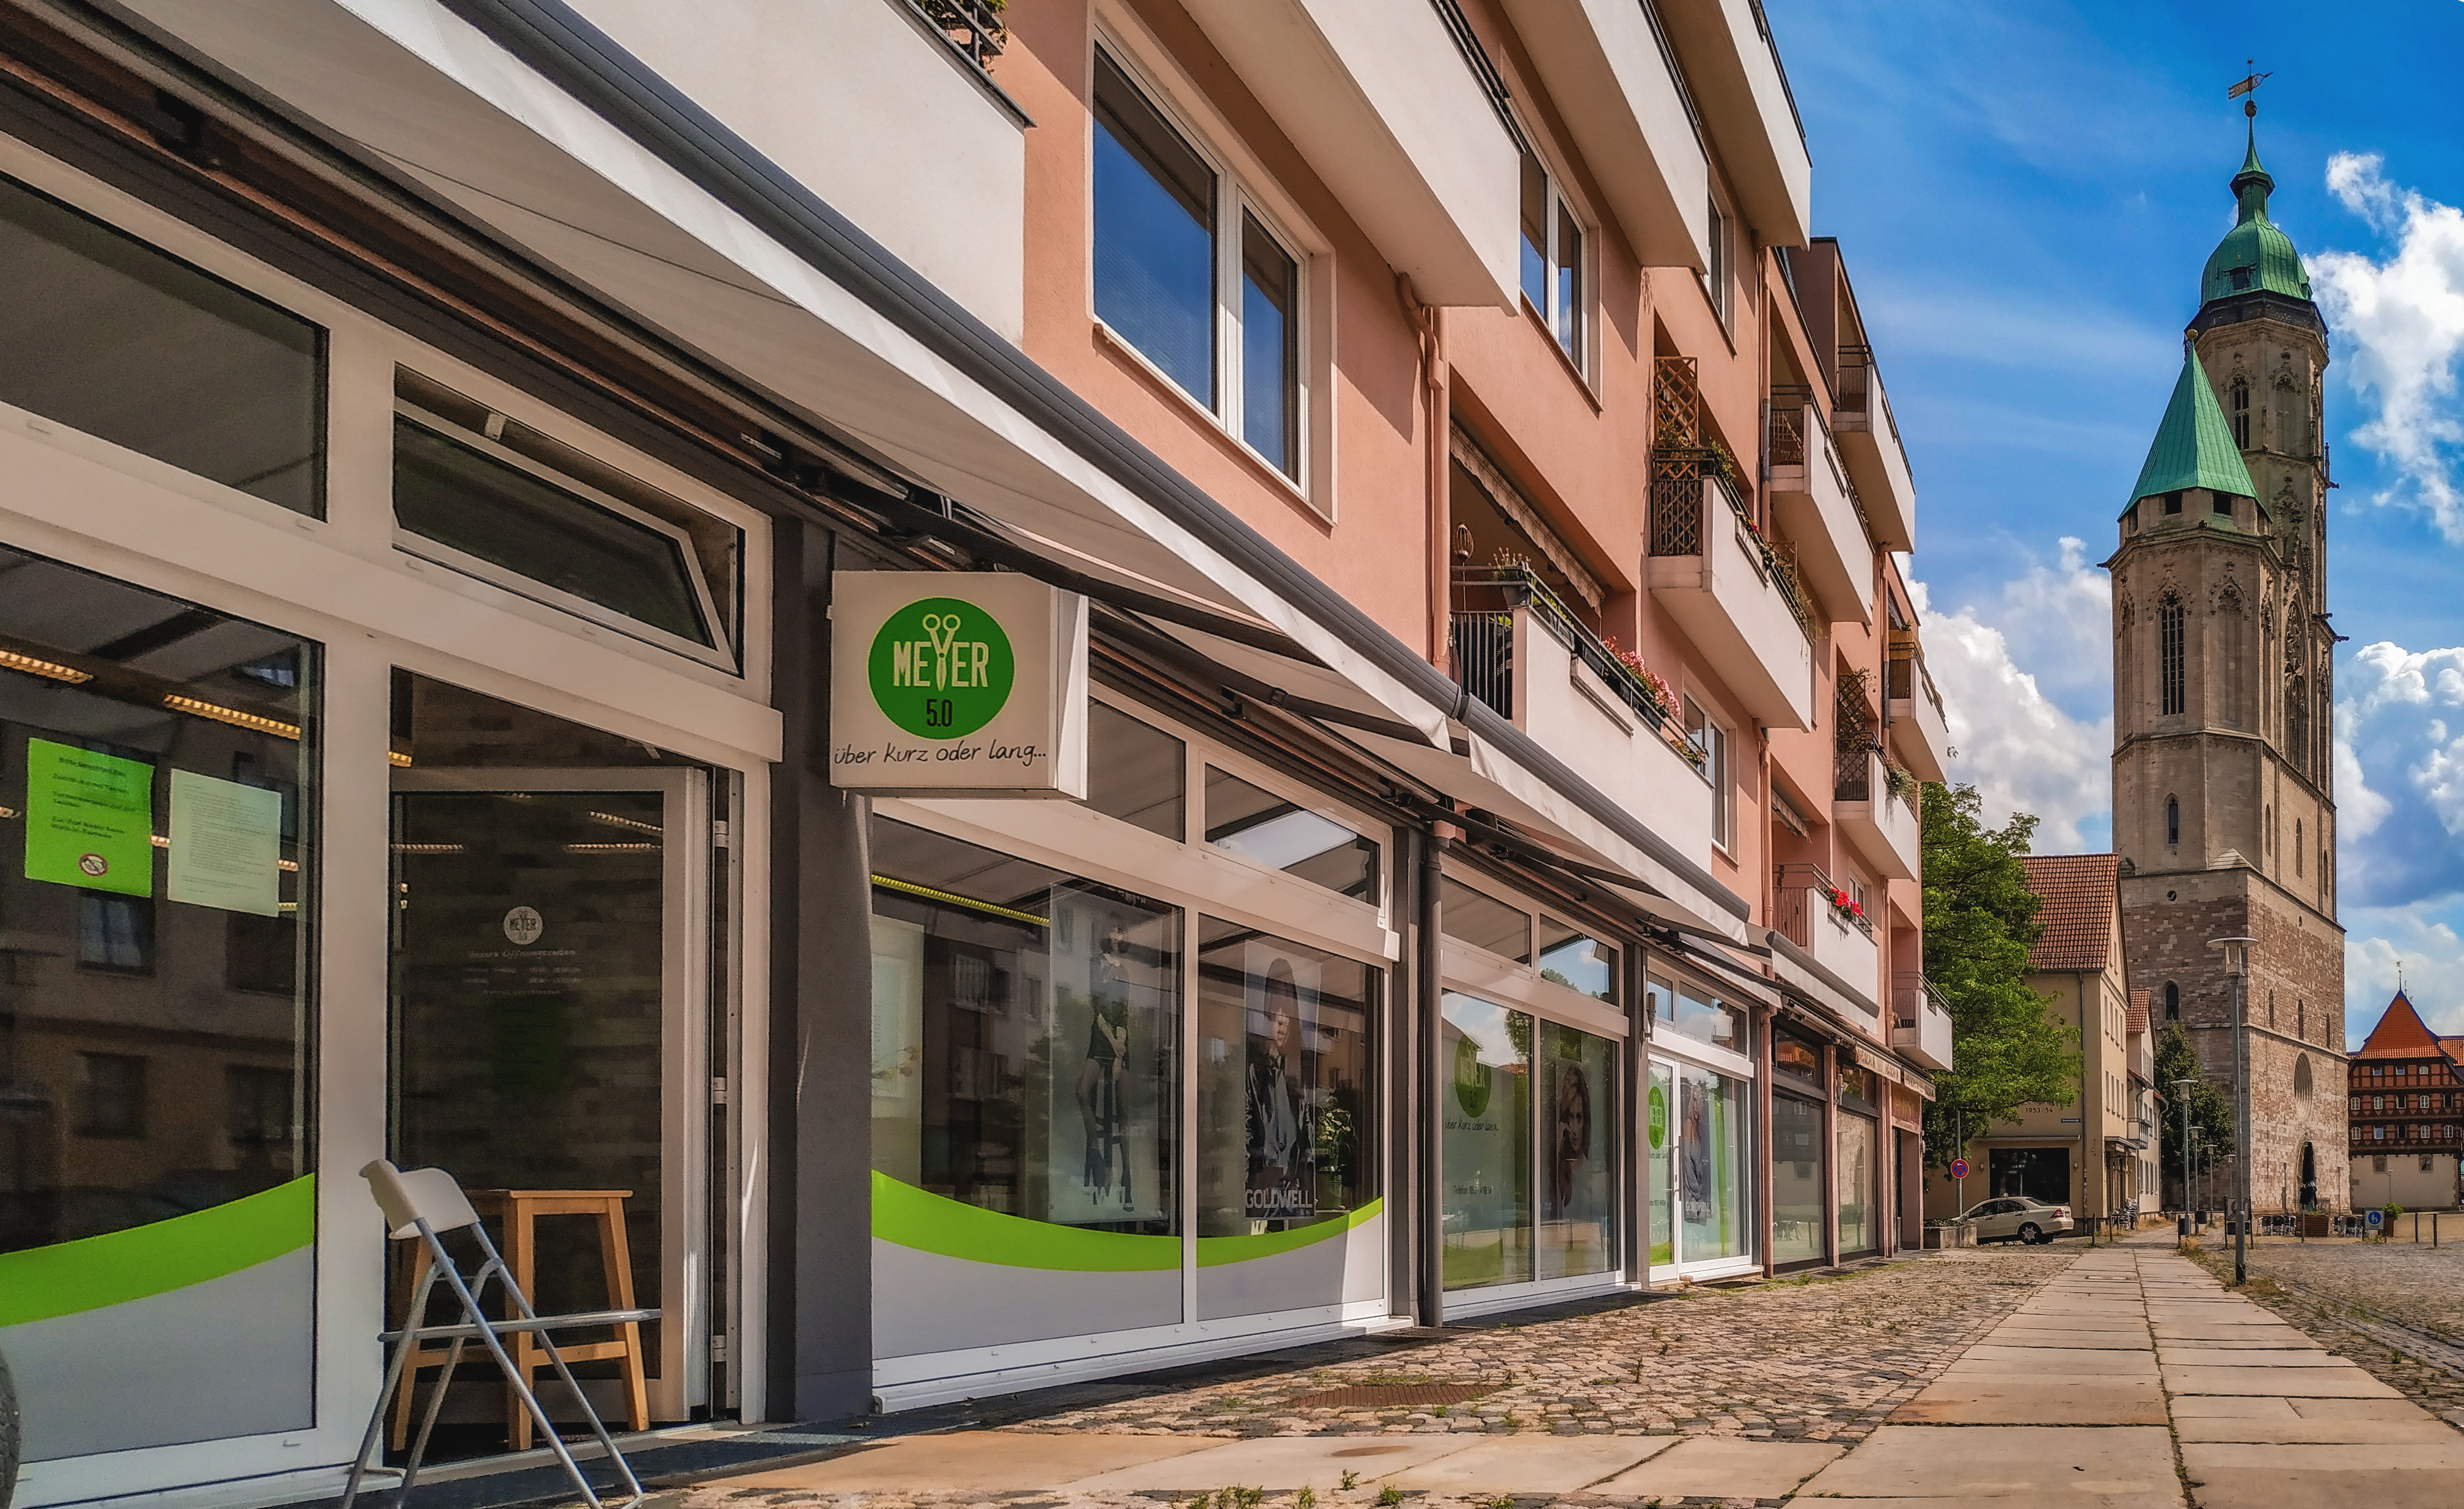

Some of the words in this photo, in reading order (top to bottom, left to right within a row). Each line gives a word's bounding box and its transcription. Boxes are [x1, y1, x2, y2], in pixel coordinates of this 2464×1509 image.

[893, 613, 989, 692] MEYER
[926, 698, 953, 728] 5.0
[834, 744, 877, 764] über
[936, 740, 981, 762] oder
[509, 910, 536, 931] MEYER
[1245, 1189, 1313, 1208] GOLDWELL
